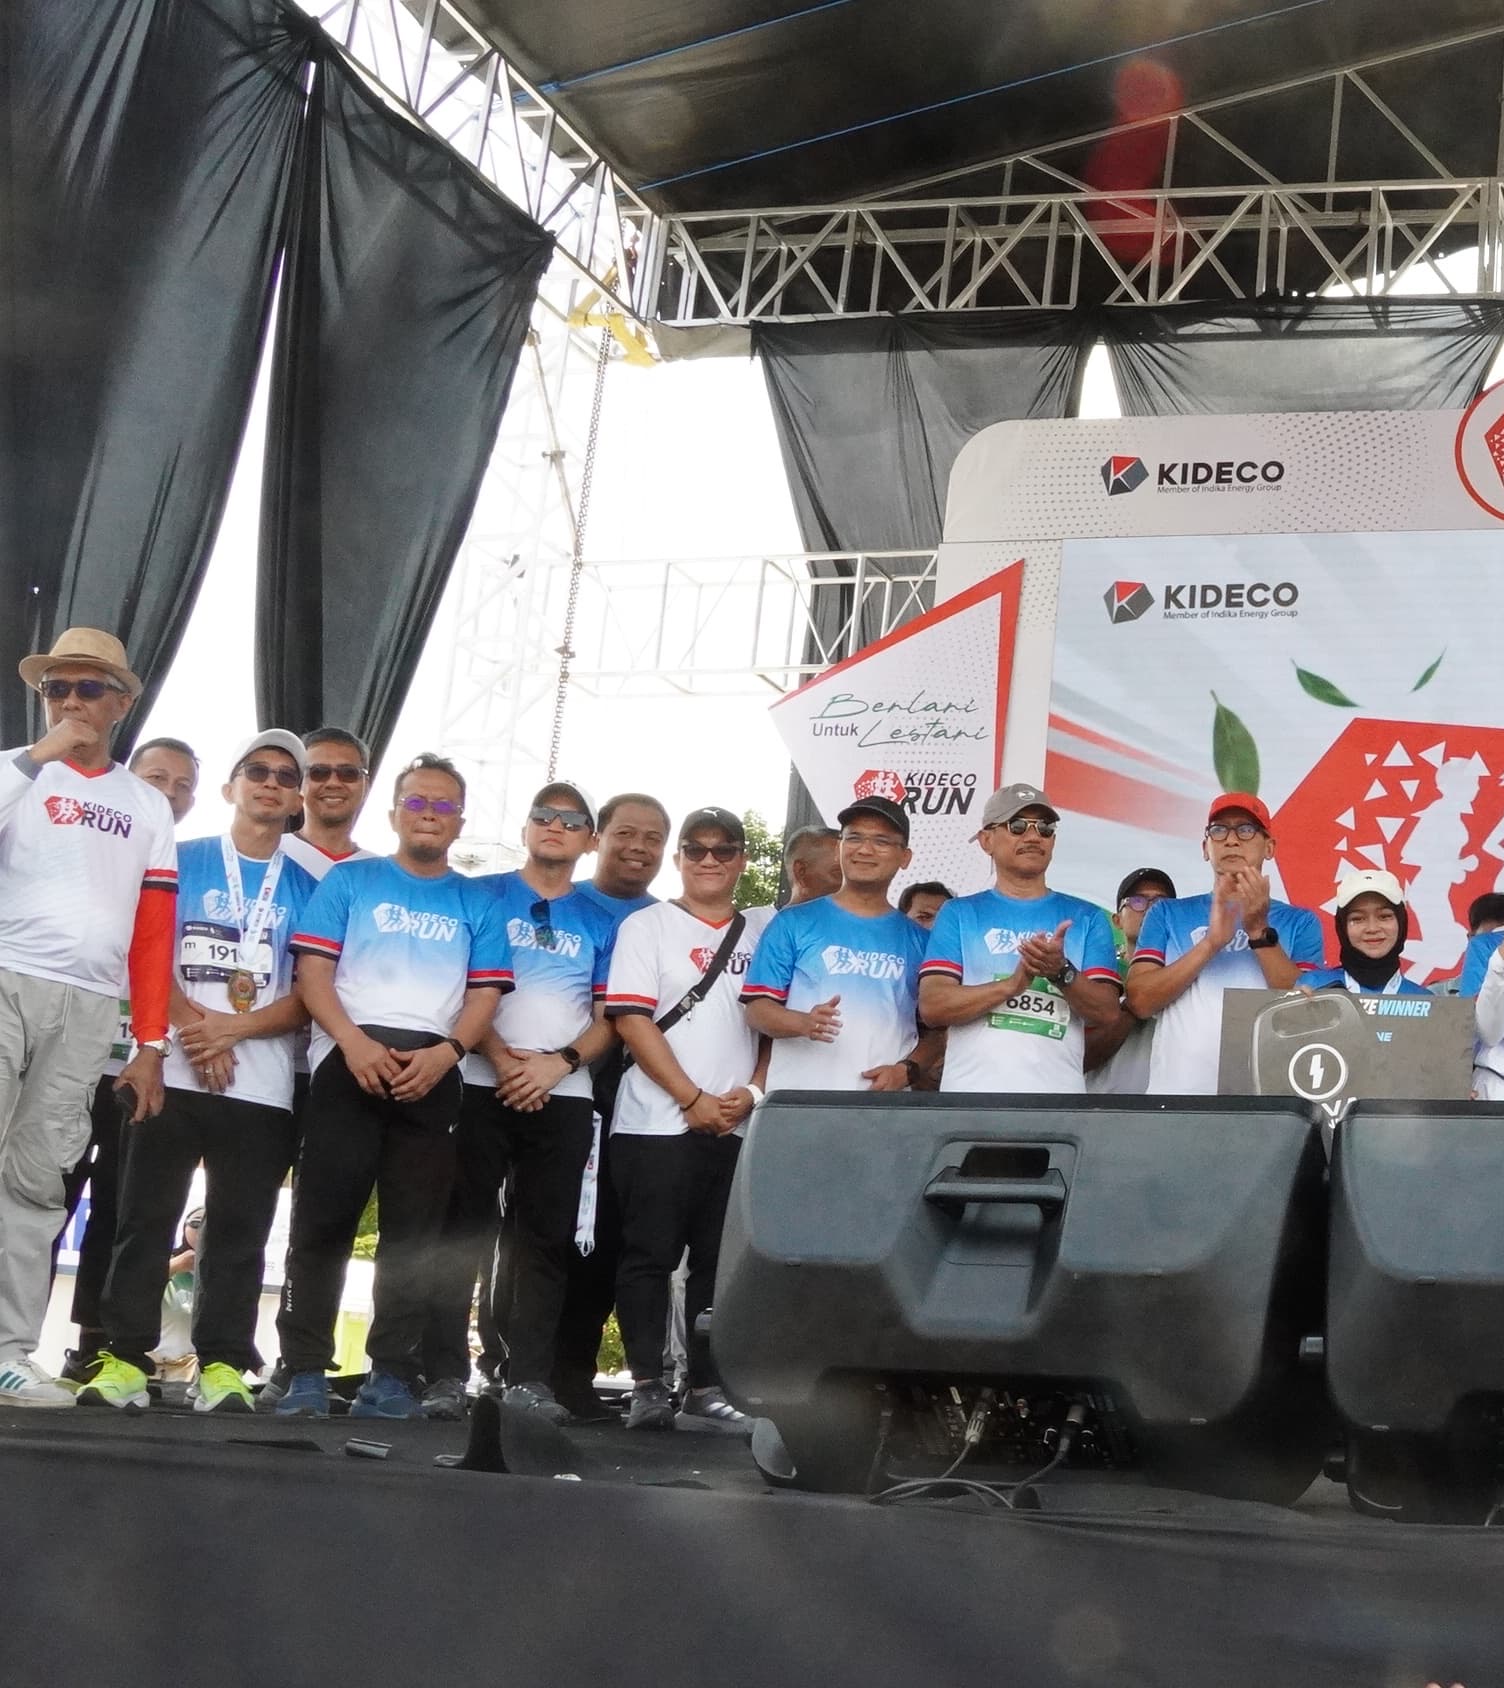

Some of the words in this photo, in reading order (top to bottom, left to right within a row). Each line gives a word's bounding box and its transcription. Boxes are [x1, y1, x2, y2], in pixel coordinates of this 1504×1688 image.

[1157, 460, 1285, 485] KIDECO
[1157, 485, 1191, 494] Member
[1192, 485, 1200, 493] of
[1201, 484, 1226, 493] Indika
[1227, 484, 1256, 494] Energy
[1256, 483, 1282, 493] Group
[1163, 582, 1299, 610] KIDECO
[1163, 610, 1198, 620] Member
[1200, 610, 1210, 619] of
[1211, 609, 1237, 619] Indika
[1239, 609, 1269, 620] Energy
[1270, 608, 1299, 619] Group
[809, 689, 979, 720] Berlari
[812, 722, 859, 737] Untuk
[857, 717, 990, 748] Lestari
[904, 772, 977, 786] KIDECO
[82, 801, 133, 823] KIDECO
[902, 787, 976, 815] RUN
[79, 810, 132, 839] RUN
[408, 911, 459, 927] KIDECO
[403, 920, 458, 942] RUN
[208, 944, 238, 963] 191
[856, 950, 905, 965] KIDECO
[849, 958, 905, 980] RUN
[1377, 999, 1432, 1017] WINNER
